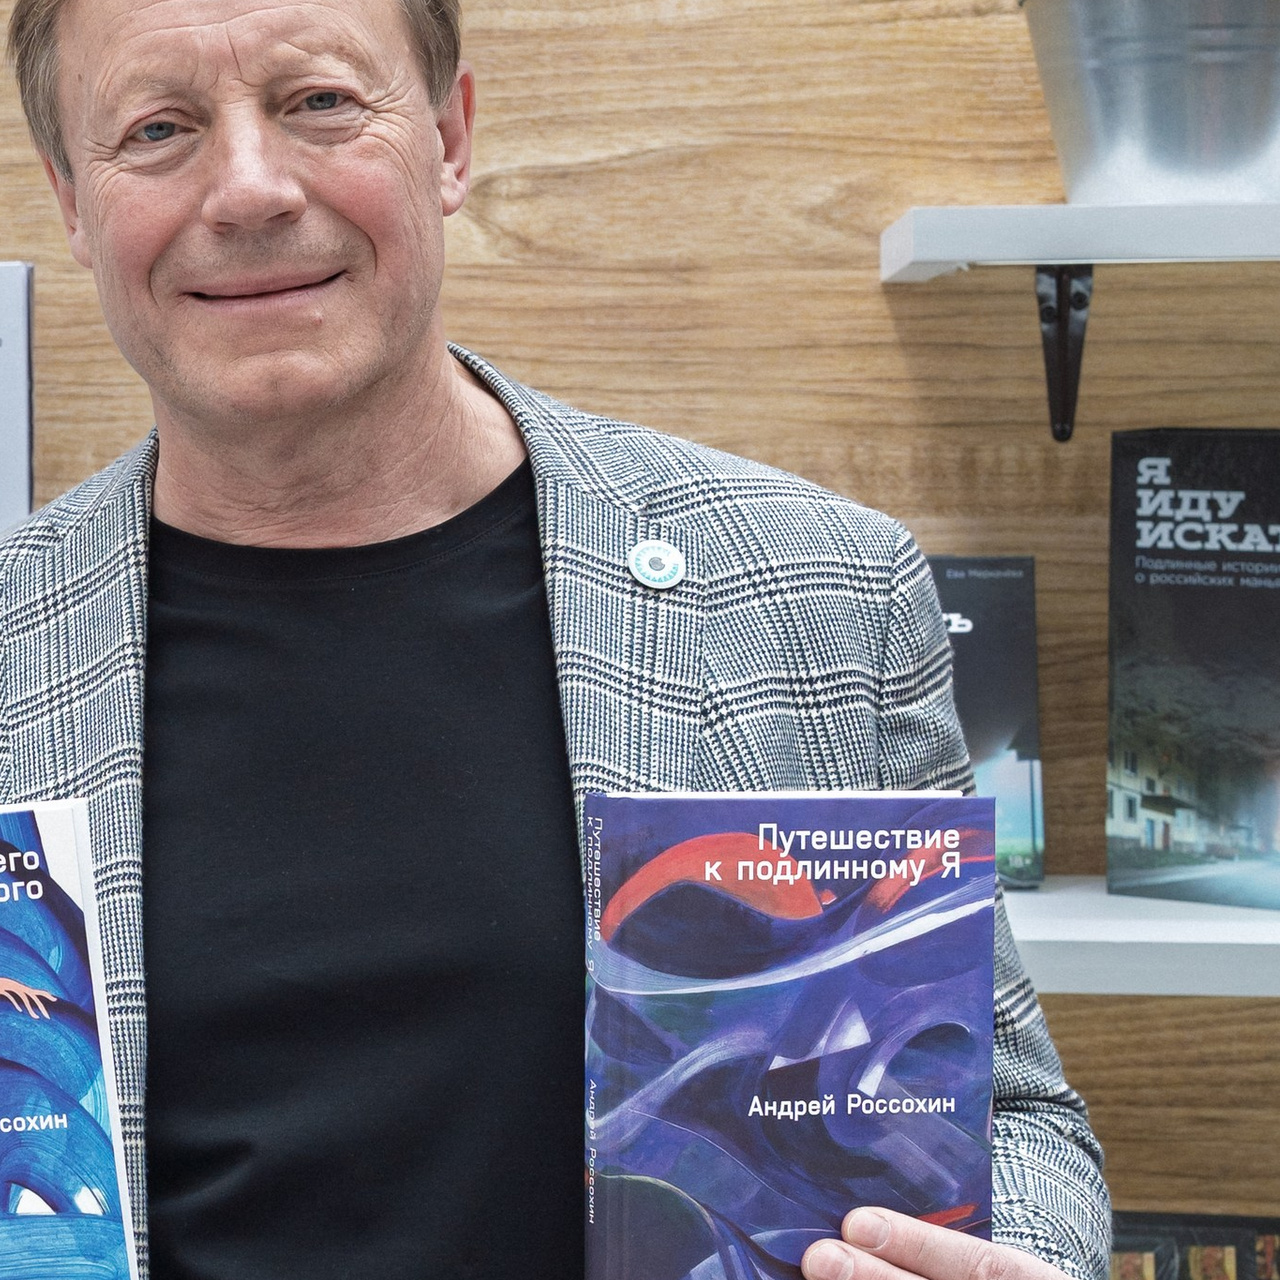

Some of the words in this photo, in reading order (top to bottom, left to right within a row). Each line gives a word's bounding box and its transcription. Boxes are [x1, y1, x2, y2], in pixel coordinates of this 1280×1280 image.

[1136, 457, 1172, 485] Я
[1136, 488, 1246, 522] ИДУ
[1135, 554, 1218, 572] Подлинные
[1149, 572, 1236, 587] российских
[758, 822, 961, 858] Путешествие
[593, 817, 604, 942] Путешествие
[704, 860, 722, 881] к
[737, 858, 927, 886] подлинному
[940, 851, 961, 879] Я
[586, 835, 594, 951] подлинному
[589, 1078, 597, 1141] Андрей
[747, 1094, 836, 1121] Андрей
[846, 1092, 956, 1115] Россохин
[588, 1146, 597, 1224] Россохин
